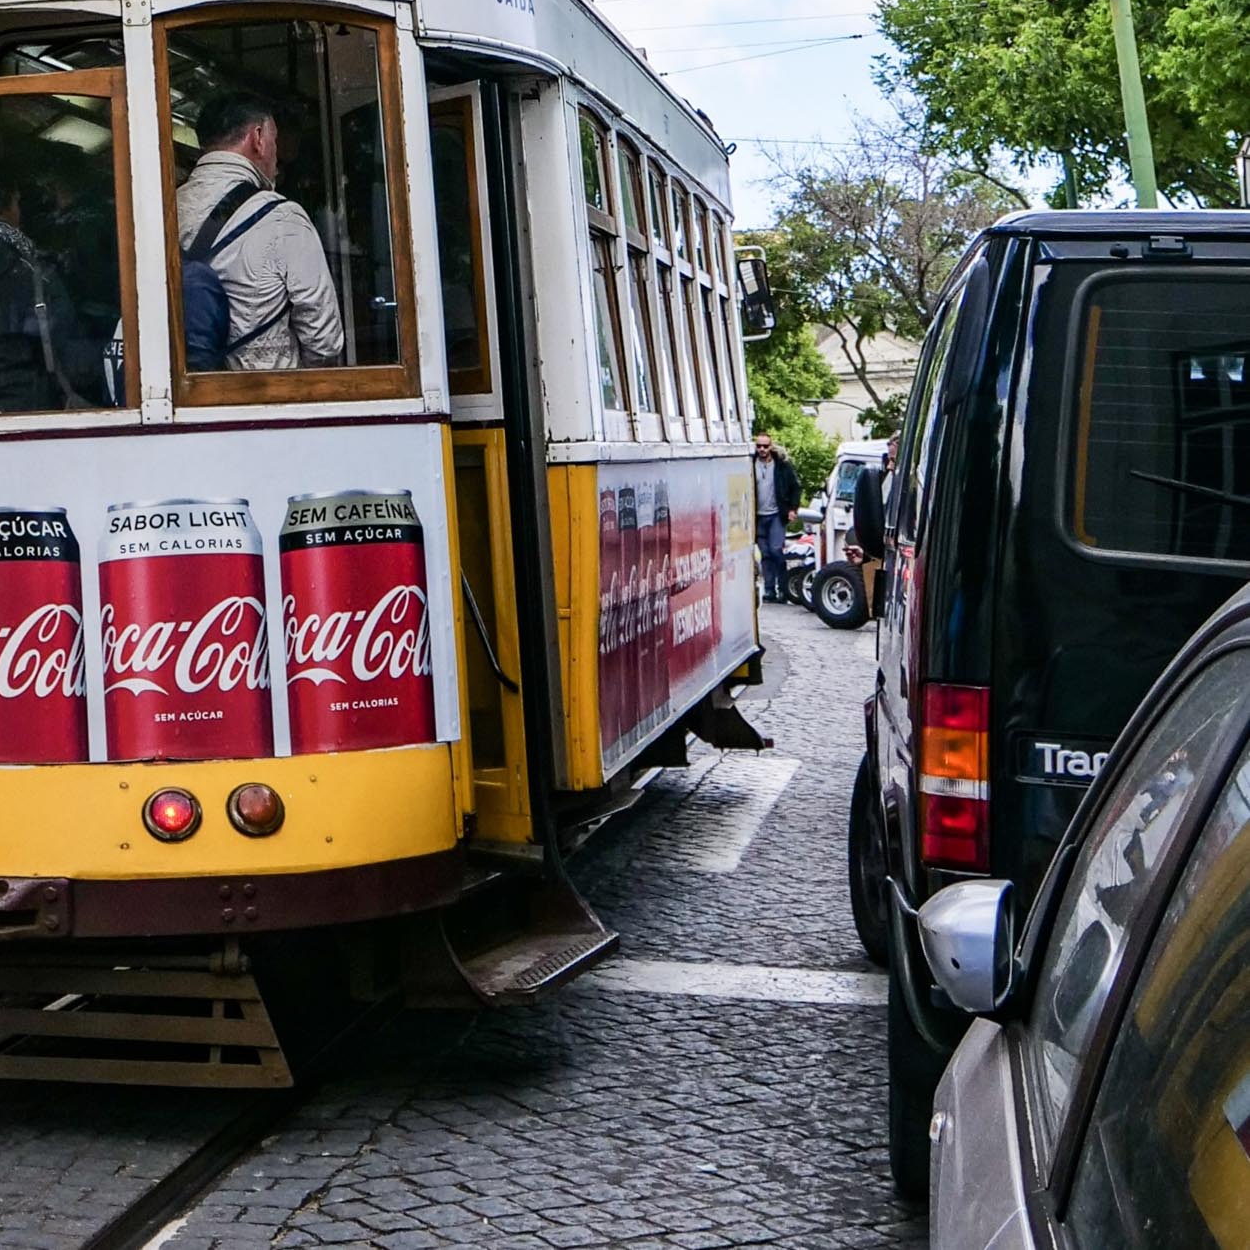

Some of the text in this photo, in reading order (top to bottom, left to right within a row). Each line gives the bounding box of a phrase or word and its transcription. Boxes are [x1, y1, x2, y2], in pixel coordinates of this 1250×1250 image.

[288, 499, 415, 527] SEM CAFEÍNA
[108, 510, 249, 534] SABOR LIGHT
[305, 527, 403, 545] SEM AÇÚCAR
[119, 538, 243, 554] SEM CALORIAS
[330, 697, 399, 712] SEM CALORIAS
[154, 709, 224, 723] SEM AÇÚCAR
